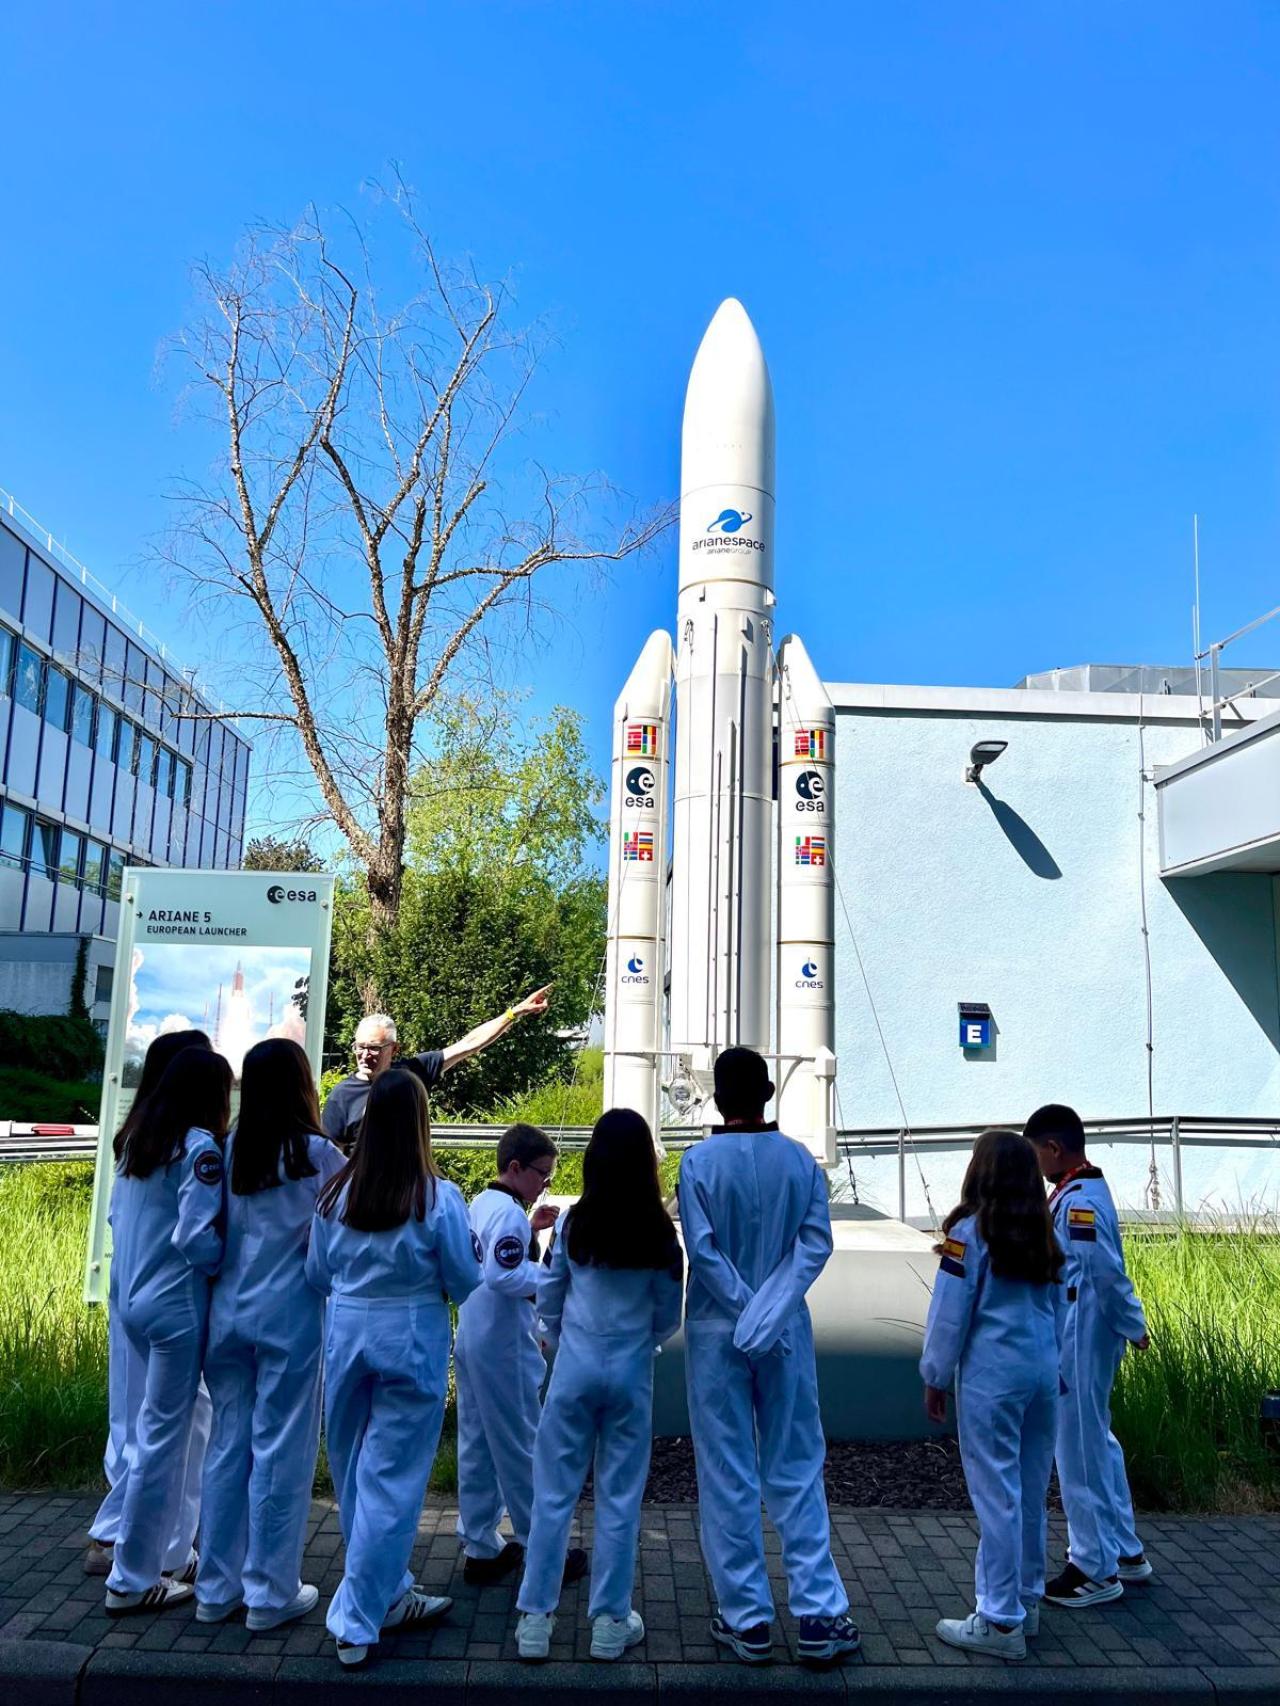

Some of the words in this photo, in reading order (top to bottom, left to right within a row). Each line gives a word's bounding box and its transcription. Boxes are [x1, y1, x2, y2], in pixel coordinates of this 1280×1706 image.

[625, 796, 655, 808] esa
[795, 800, 825, 813] esa
[286, 890, 317, 902] esa
[148, 910, 199, 923] ARIANE
[203, 911, 212, 923] 5
[146, 925, 196, 935] EUROPEAN
[198, 926, 247, 937] LAUNCHER
[621, 975, 650, 984] cnes
[795, 980, 824, 989] cnes
[967, 1024, 982, 1043] E
